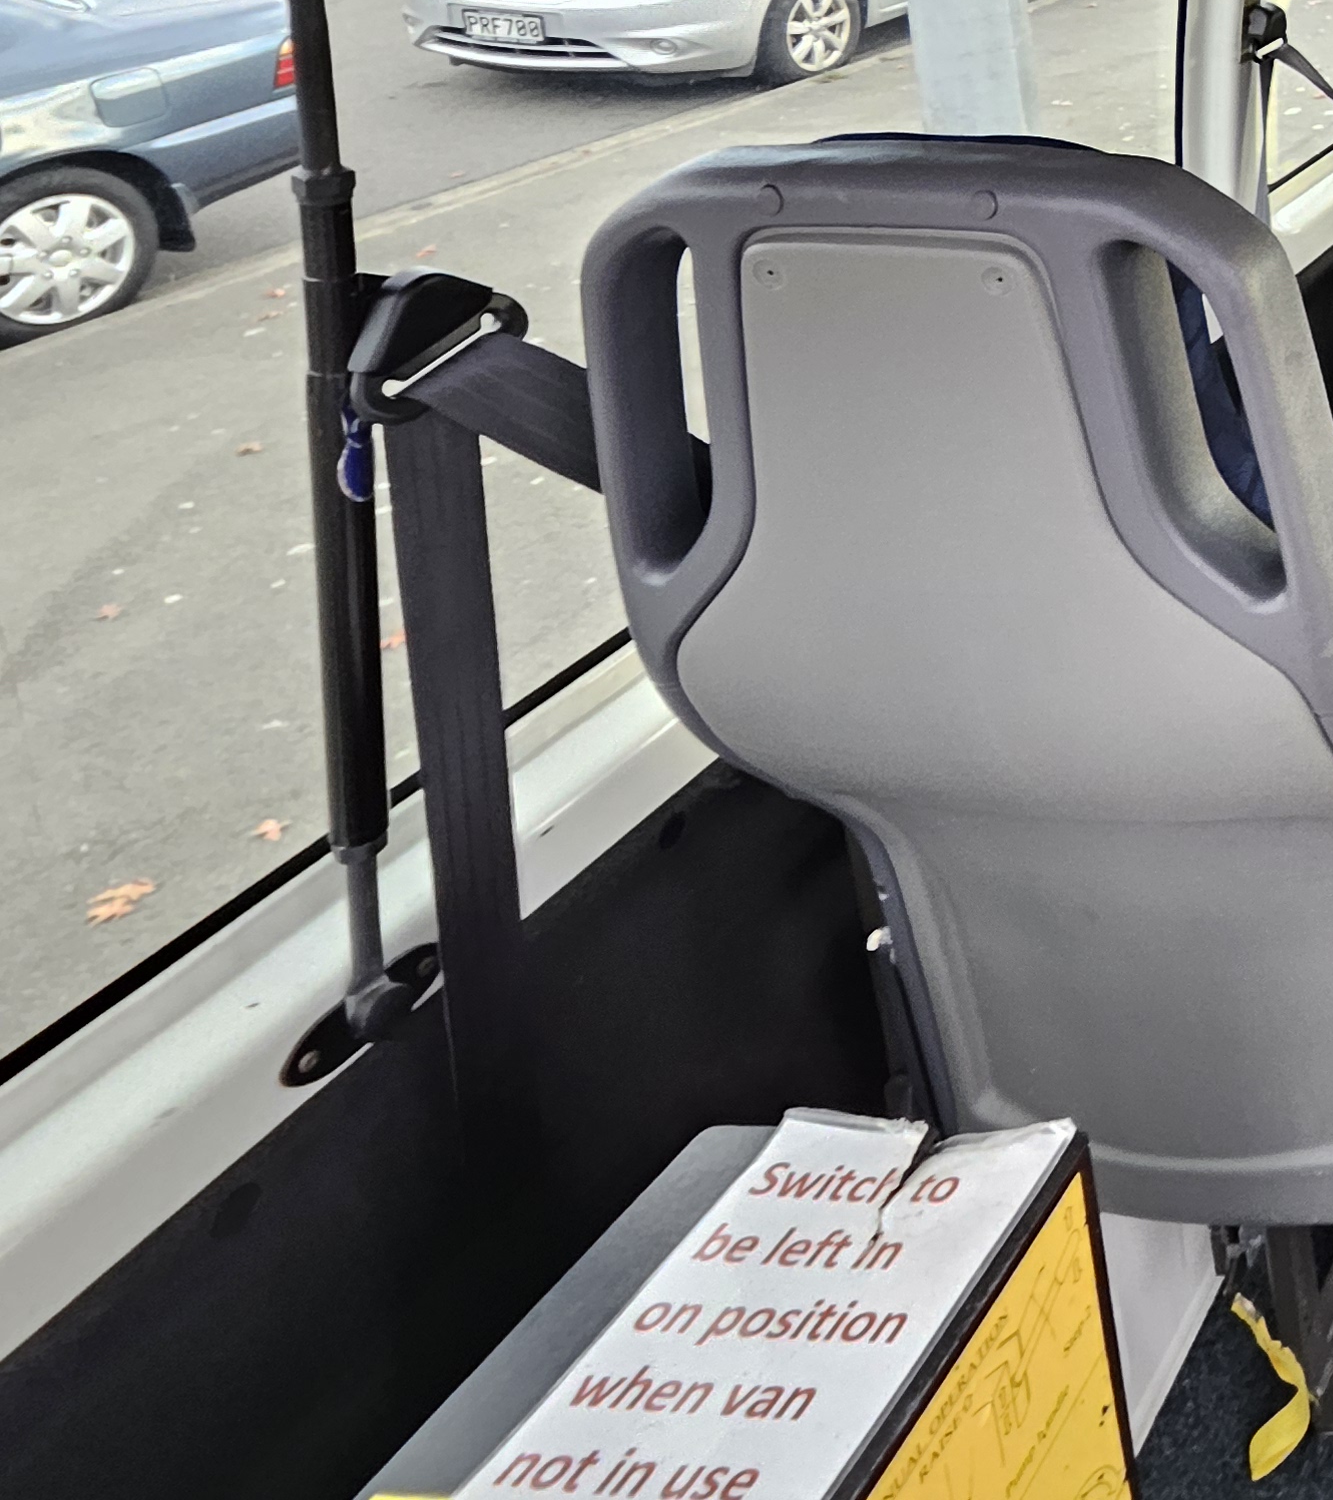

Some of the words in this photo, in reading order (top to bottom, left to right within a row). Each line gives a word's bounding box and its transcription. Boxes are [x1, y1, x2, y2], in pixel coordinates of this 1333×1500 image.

[910, 1173, 960, 1205] to
[692, 1223, 760, 1264] be
[761, 1227, 852, 1270] left
[851, 1232, 904, 1271] in
[632, 1301, 703, 1334] on
[694, 1299, 909, 1346] position
[569, 1366, 715, 1414] when
[720, 1383, 817, 1421] van
[493, 1450, 600, 1494] not
[594, 1447, 657, 1496] in
[659, 1463, 760, 1500] use
